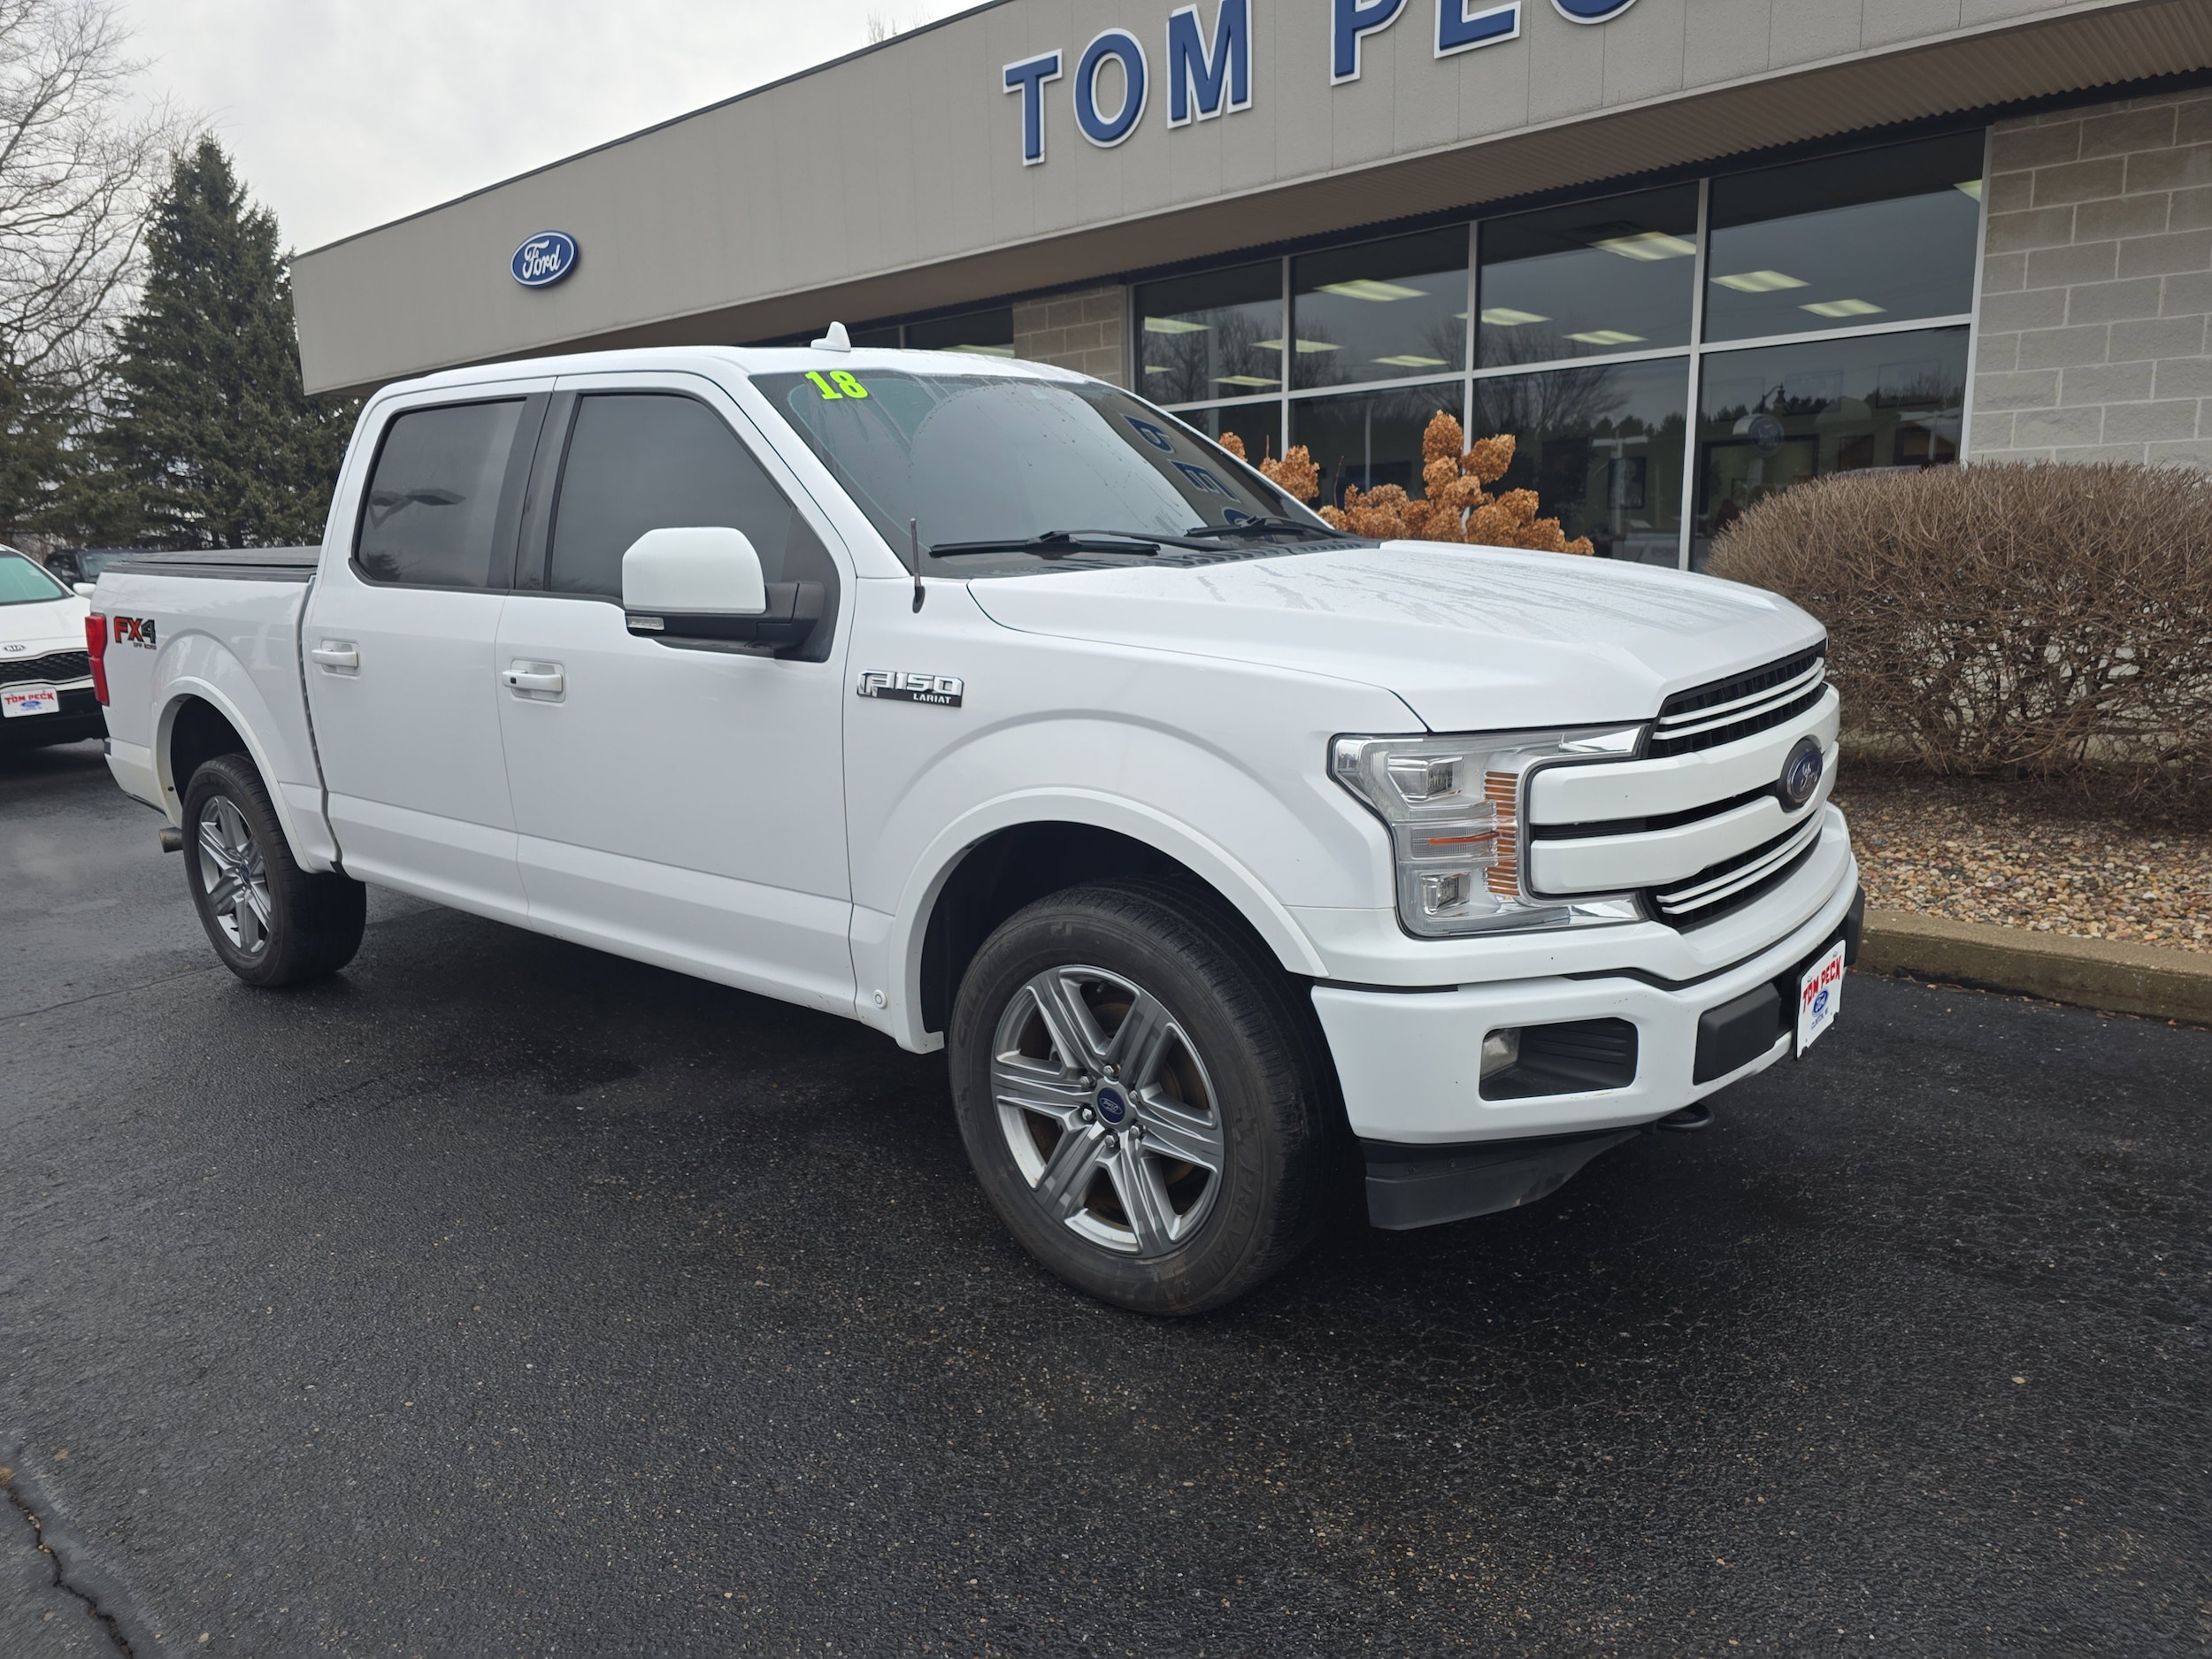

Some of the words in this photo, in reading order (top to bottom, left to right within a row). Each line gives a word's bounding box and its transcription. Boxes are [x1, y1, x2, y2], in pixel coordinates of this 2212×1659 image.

[1002, 0, 1253, 166] TOM
[522, 239, 561, 279] Ford
[804, 370, 868, 400] 18
[113, 616, 157, 644] FX4
[4, 695, 26, 705] TOM
[28, 692, 55, 702] PECK
[913, 693, 952, 704] LARIAT
[1802, 976, 1819, 1014] TOM
[1821, 955, 1842, 988] PECK
